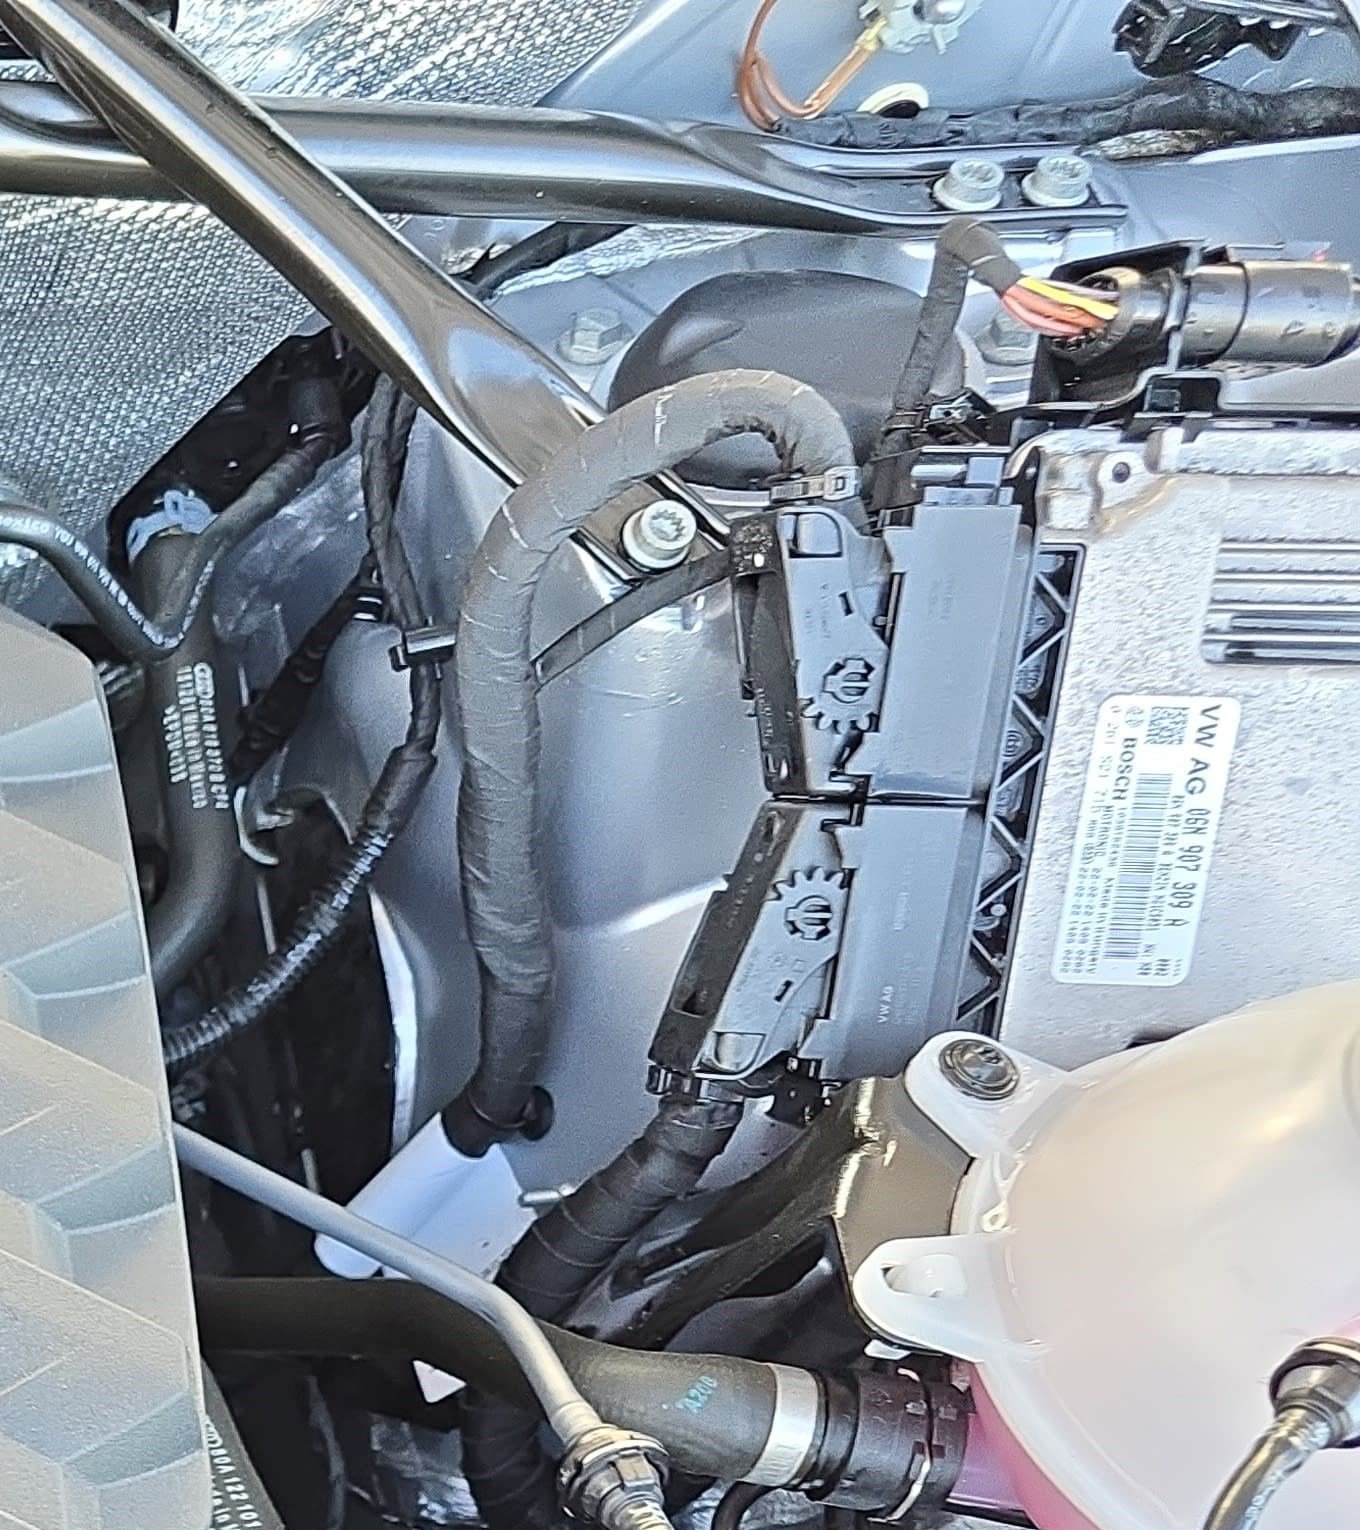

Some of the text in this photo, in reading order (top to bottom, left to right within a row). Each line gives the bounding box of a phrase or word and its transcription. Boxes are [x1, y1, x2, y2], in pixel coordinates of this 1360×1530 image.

[1194, 703, 1223, 748] VW
[1111, 737, 1139, 801] BOSCH
[1185, 757, 1211, 795] AG
[1176, 845, 1205, 872] 907
[224, 1477, 250, 1501] 122
[236, 1503, 263, 1528] 101
